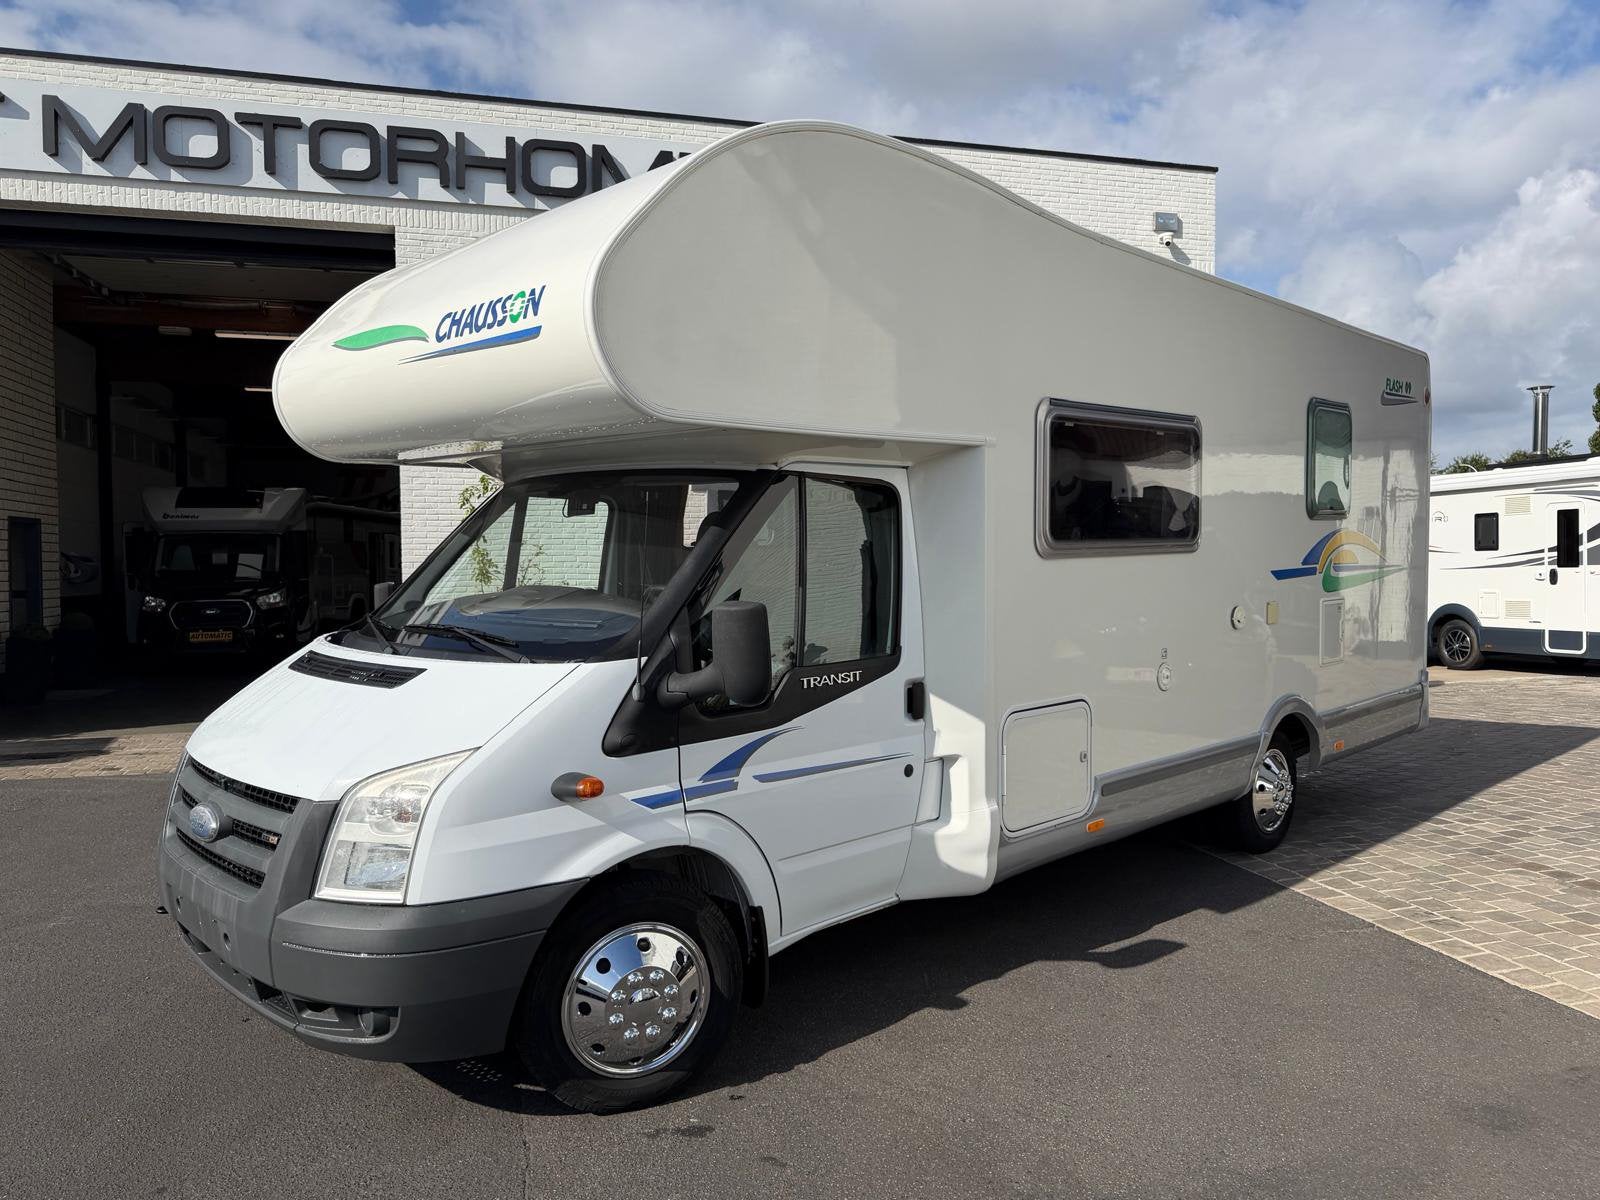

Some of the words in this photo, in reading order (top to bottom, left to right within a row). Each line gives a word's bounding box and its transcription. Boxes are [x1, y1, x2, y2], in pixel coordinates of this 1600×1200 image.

[42, 94, 692, 198] MOTORHOM
[435, 285, 546, 343] CHAUSSON
[1385, 377, 1404, 394] FLASH
[191, 632, 232, 641] AUTOMATIC
[800, 670, 863, 689] TRANSIT
